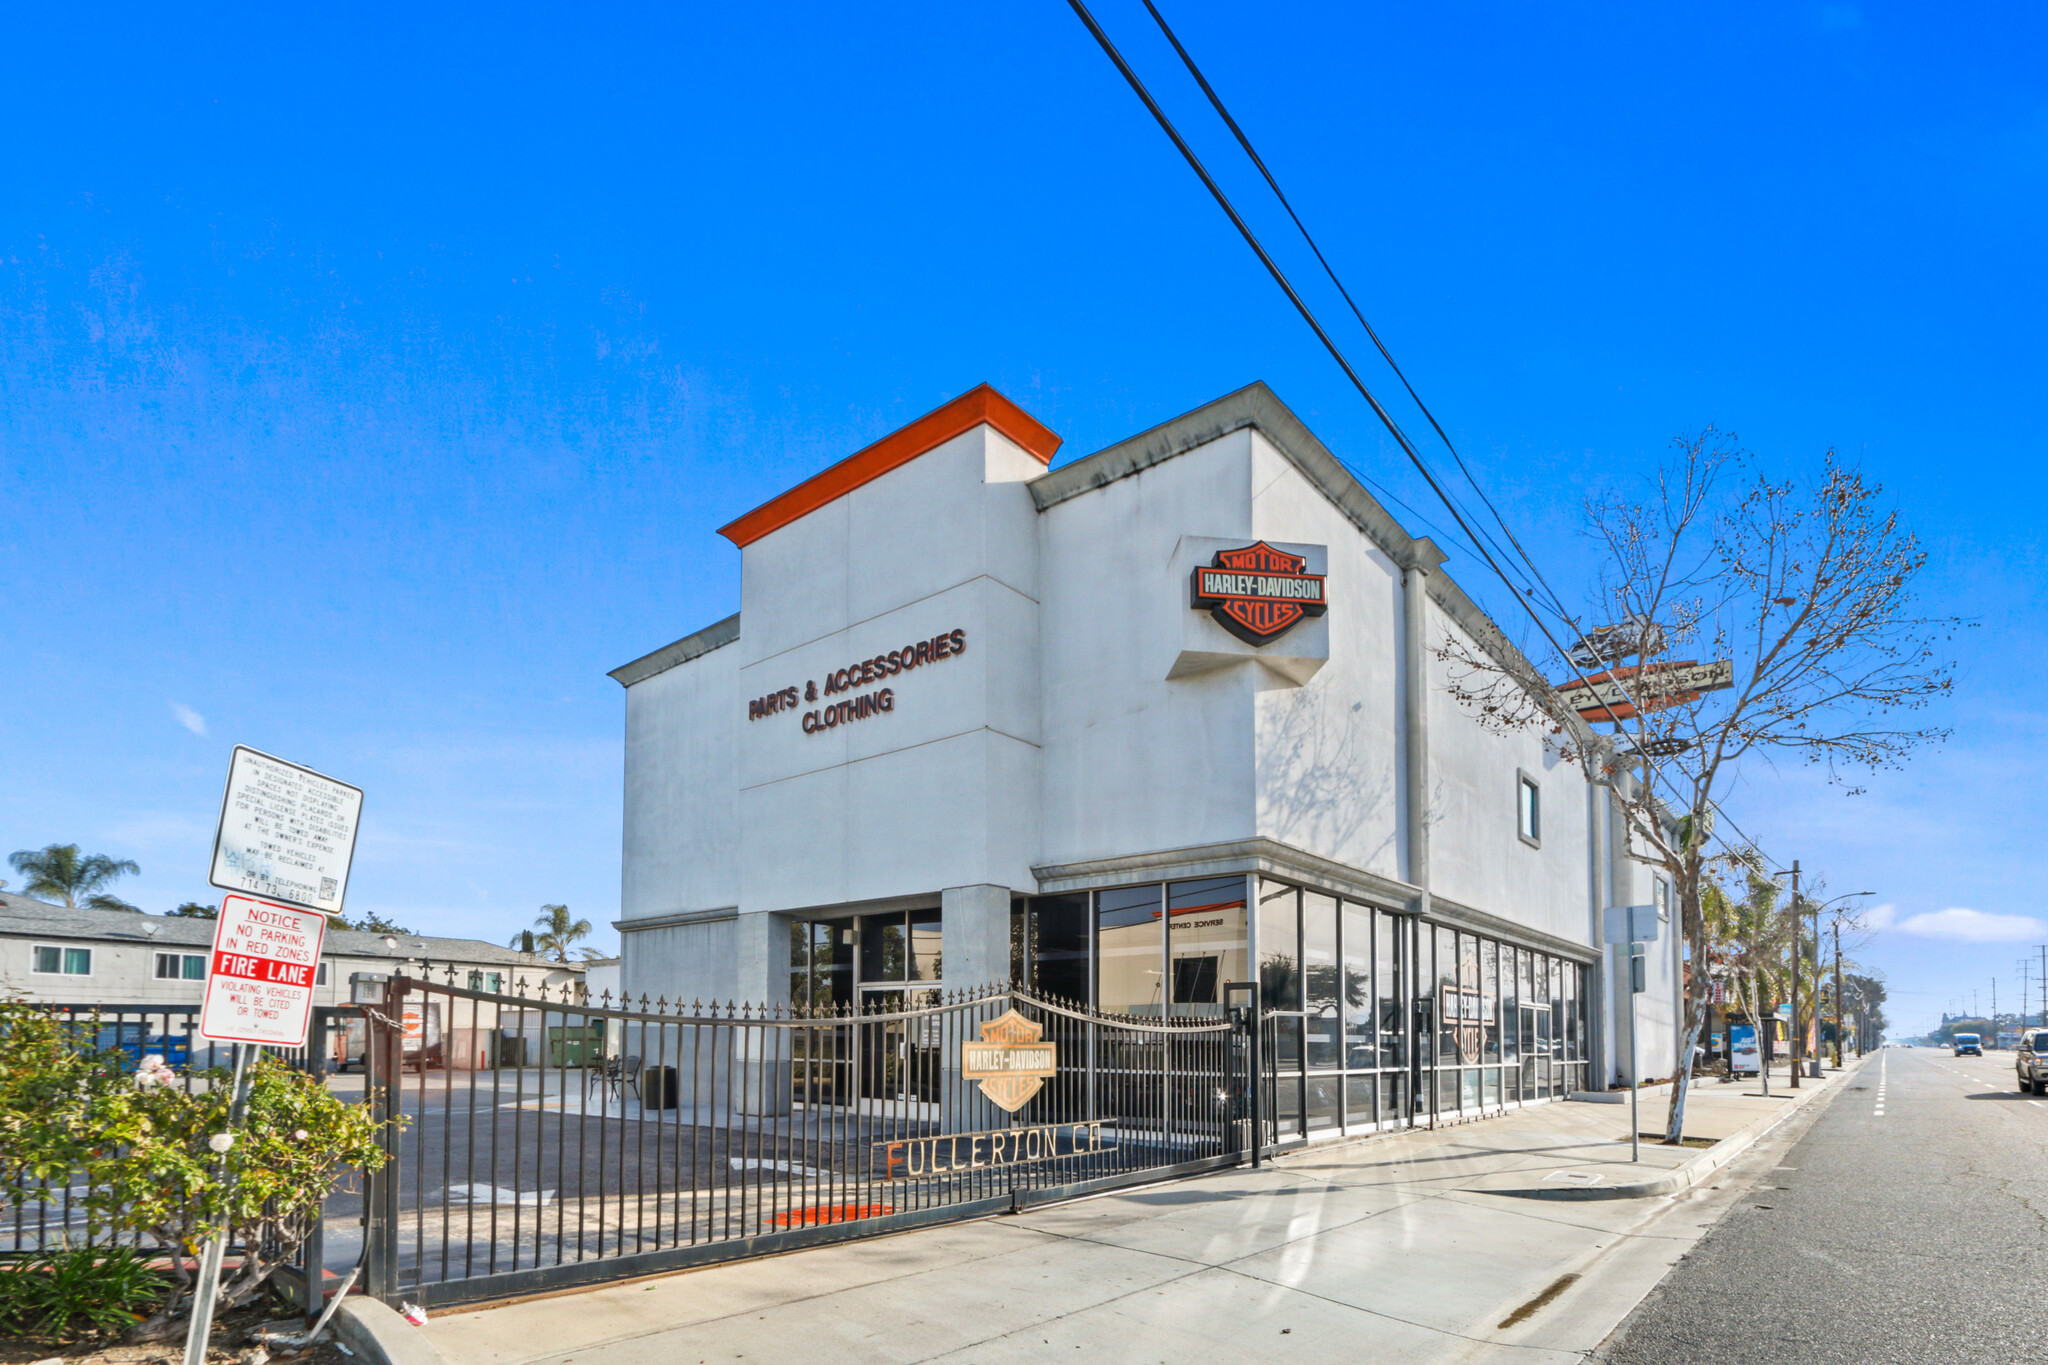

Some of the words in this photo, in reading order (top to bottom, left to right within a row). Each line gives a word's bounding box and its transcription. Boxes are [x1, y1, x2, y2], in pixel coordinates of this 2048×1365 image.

[1233, 550, 1292, 572] MOTOR
[1205, 573, 1320, 599] HARLEY-DAVIDSON
[1233, 602, 1293, 629] CYCLES
[749, 686, 799, 721] PARTS
[805, 680, 818, 702] &
[824, 629, 966, 696] ACCESSORIES
[802, 688, 894, 734] CLOTHING
[244, 757, 293, 778] UNAUTHORIZED
[299, 774, 328, 791] VEHICLES
[332, 787, 355, 800] PARKED
[265, 772, 303, 790] DESIGNATED
[308, 789, 344, 804] ACCESSIBLE
[245, 785, 296, 806] DISTINGUISHING
[301, 804, 332, 818] PLACARDS
[337, 814, 345, 822] OR
[258, 780, 281, 794] SPACES
[286, 789, 298, 797] NOT
[303, 795, 338, 811] DISPLAYING
[236, 801, 249, 811] FOR
[255, 808, 284, 822] PERSONS
[290, 818, 305, 827] WITH
[309, 822, 346, 840] DISABILITIES
[237, 792, 265, 806] SPECIAL
[270, 803, 296, 818] LICENSE
[302, 812, 324, 825] PLATES
[328, 820, 348, 832] ISSUED
[255, 818, 269, 827] WILL
[275, 822, 282, 830] BE
[289, 826, 308, 838] TOWED
[314, 834, 328, 843] AWAY
[258, 826, 269, 835] THE
[275, 831, 302, 845] OWNER'S
[307, 840, 334, 853] EXPENSE
[260, 841, 280, 852] TOWED
[287, 848, 316, 862] VEHICLES
[264, 852, 272, 860] BE
[278, 855, 313, 870] RECLAIMED
[241, 878, 258, 888] 714
[289, 889, 313, 903] 6800
[247, 870, 256, 878] OR
[260, 873, 269, 882] BY
[275, 877, 316, 893] TELEPHONING
[248, 909, 301, 929] NOTICE
[237, 925, 252, 937] NO
[261, 929, 305, 947] PARKING
[226, 938, 237, 949] IN
[247, 941, 268, 954] RED
[276, 946, 309, 962] ZONES
[220, 955, 258, 977] FIRE
[267, 966, 308, 985] LANE
[221, 981, 261, 994] VIOLATING
[267, 988, 301, 1000] VEHICLES
[230, 994, 246, 1005] WILL
[269, 1000, 290, 1009] CITED
[238, 1007, 247, 1016] OR
[254, 1009, 279, 1020] TOWED
[990, 1024, 1034, 1043] MOTOR
[969, 1050, 1051, 1071] HARLEY-DAVIDSON
[990, 1077, 1034, 1099] CYCLES
[886, 1128, 1057, 1180] FULLERTON
[1072, 1123, 1101, 1153] CA
